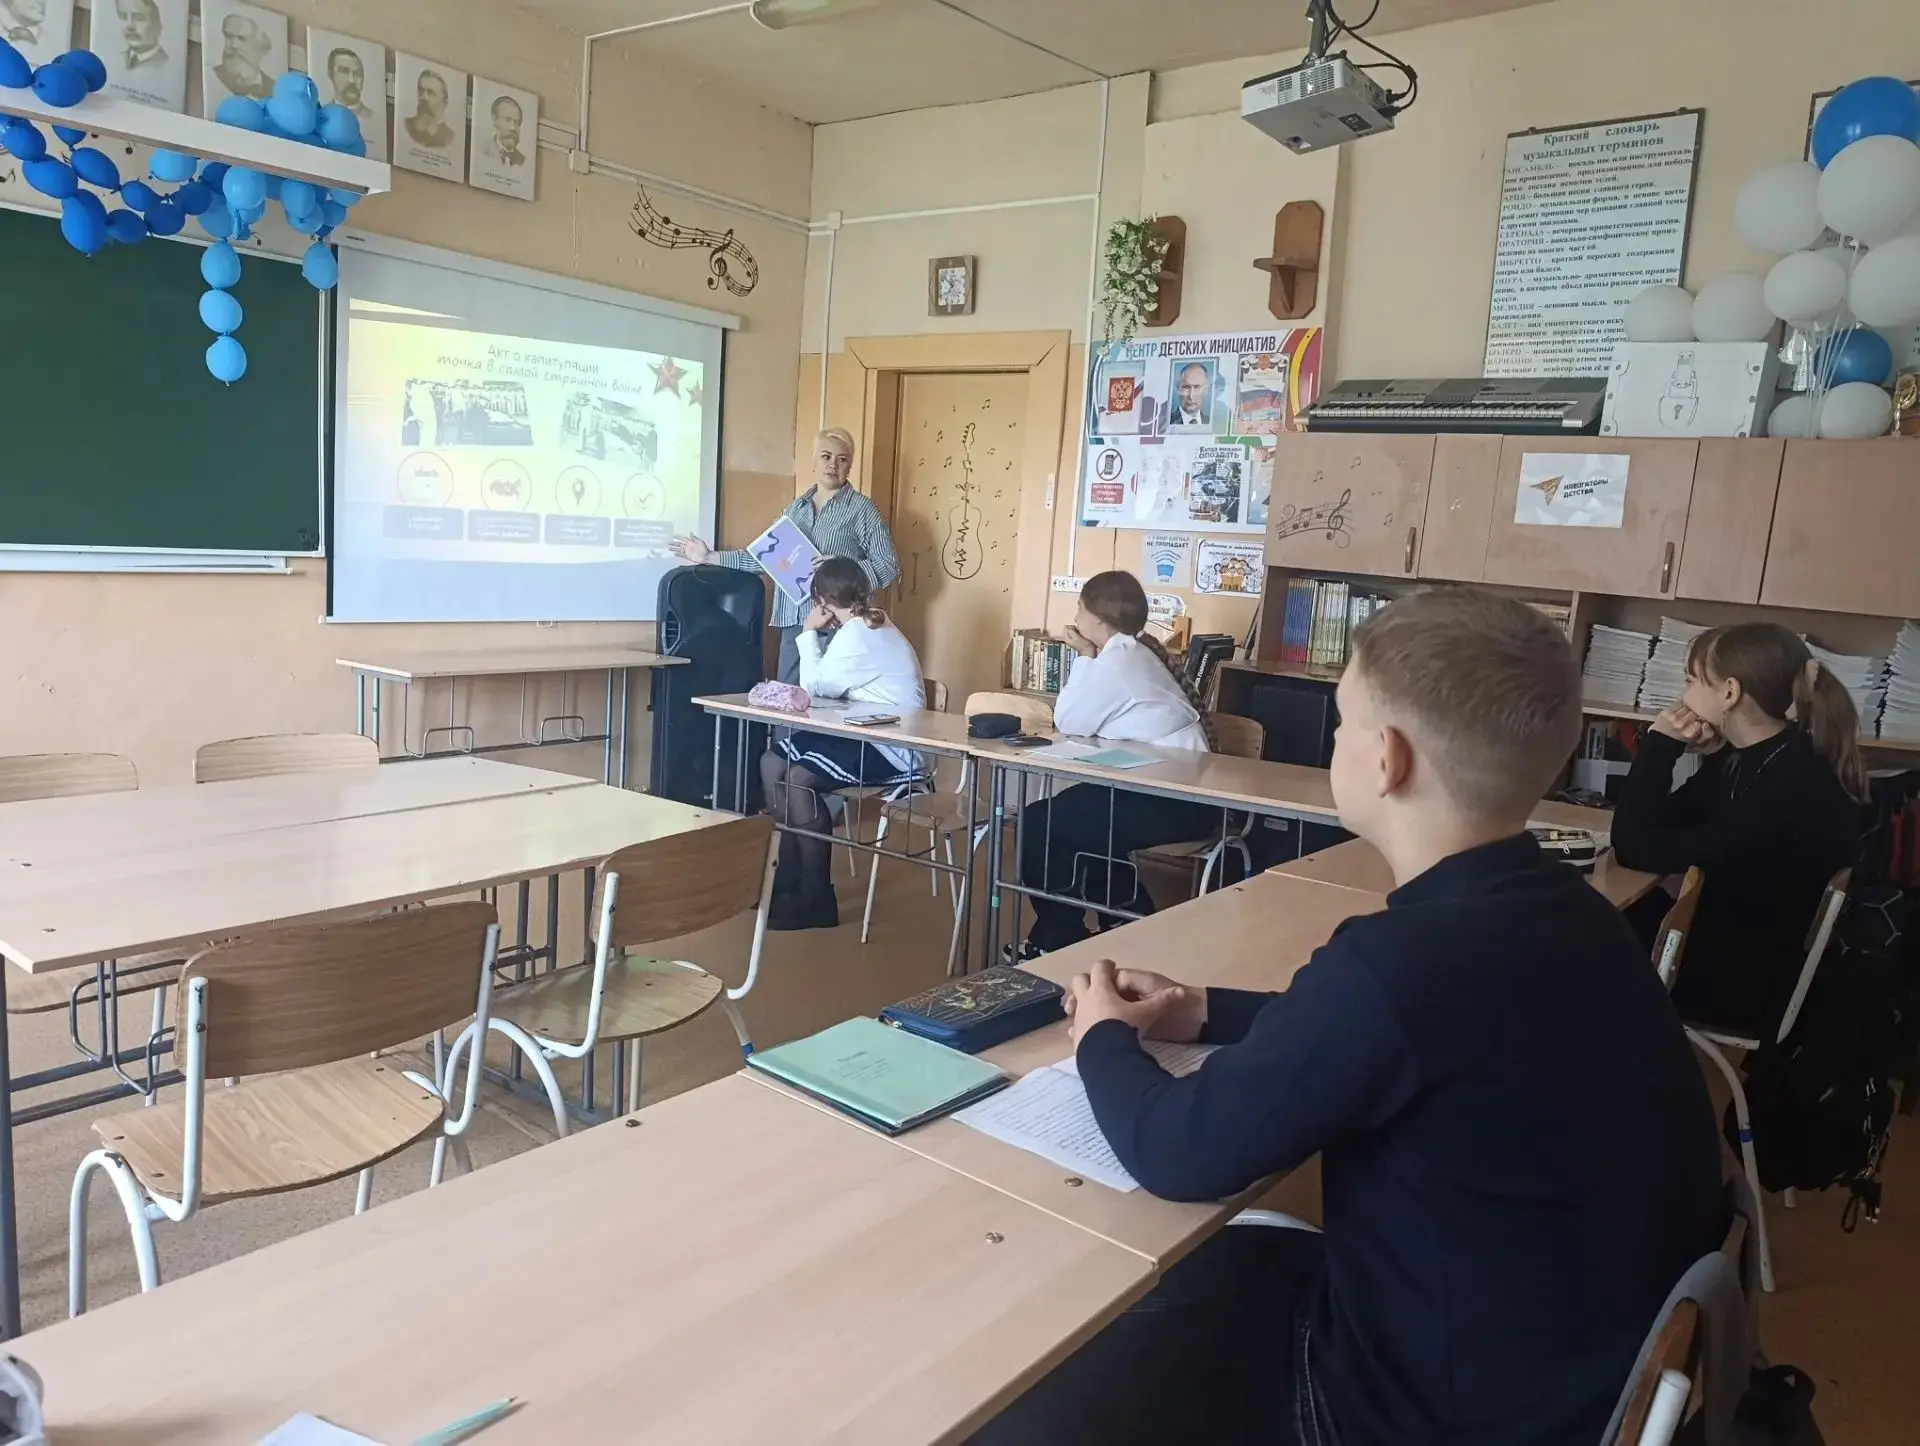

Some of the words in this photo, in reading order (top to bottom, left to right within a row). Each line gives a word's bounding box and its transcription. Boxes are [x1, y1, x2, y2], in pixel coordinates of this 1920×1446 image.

[1543, 130, 1590, 146] Краткий
[1605, 122, 1661, 136] словарь
[1522, 145, 1597, 163] музыкальных
[1598, 137, 1665, 153] терминов
[1158, 339, 1207, 358] ДЕТСКИХ
[1209, 335, 1277, 354] ИНИЦИАТИВ
[437, 354, 482, 370] точка
[499, 365, 539, 378] самой
[487, 344, 510, 358] Акт
[513, 352, 521, 361] о
[524, 353, 599, 374] капитуляции
[1563, 478, 1609, 490] НАВИГАТОРЫ
[1563, 488, 1594, 499] ДЕТСТВА
